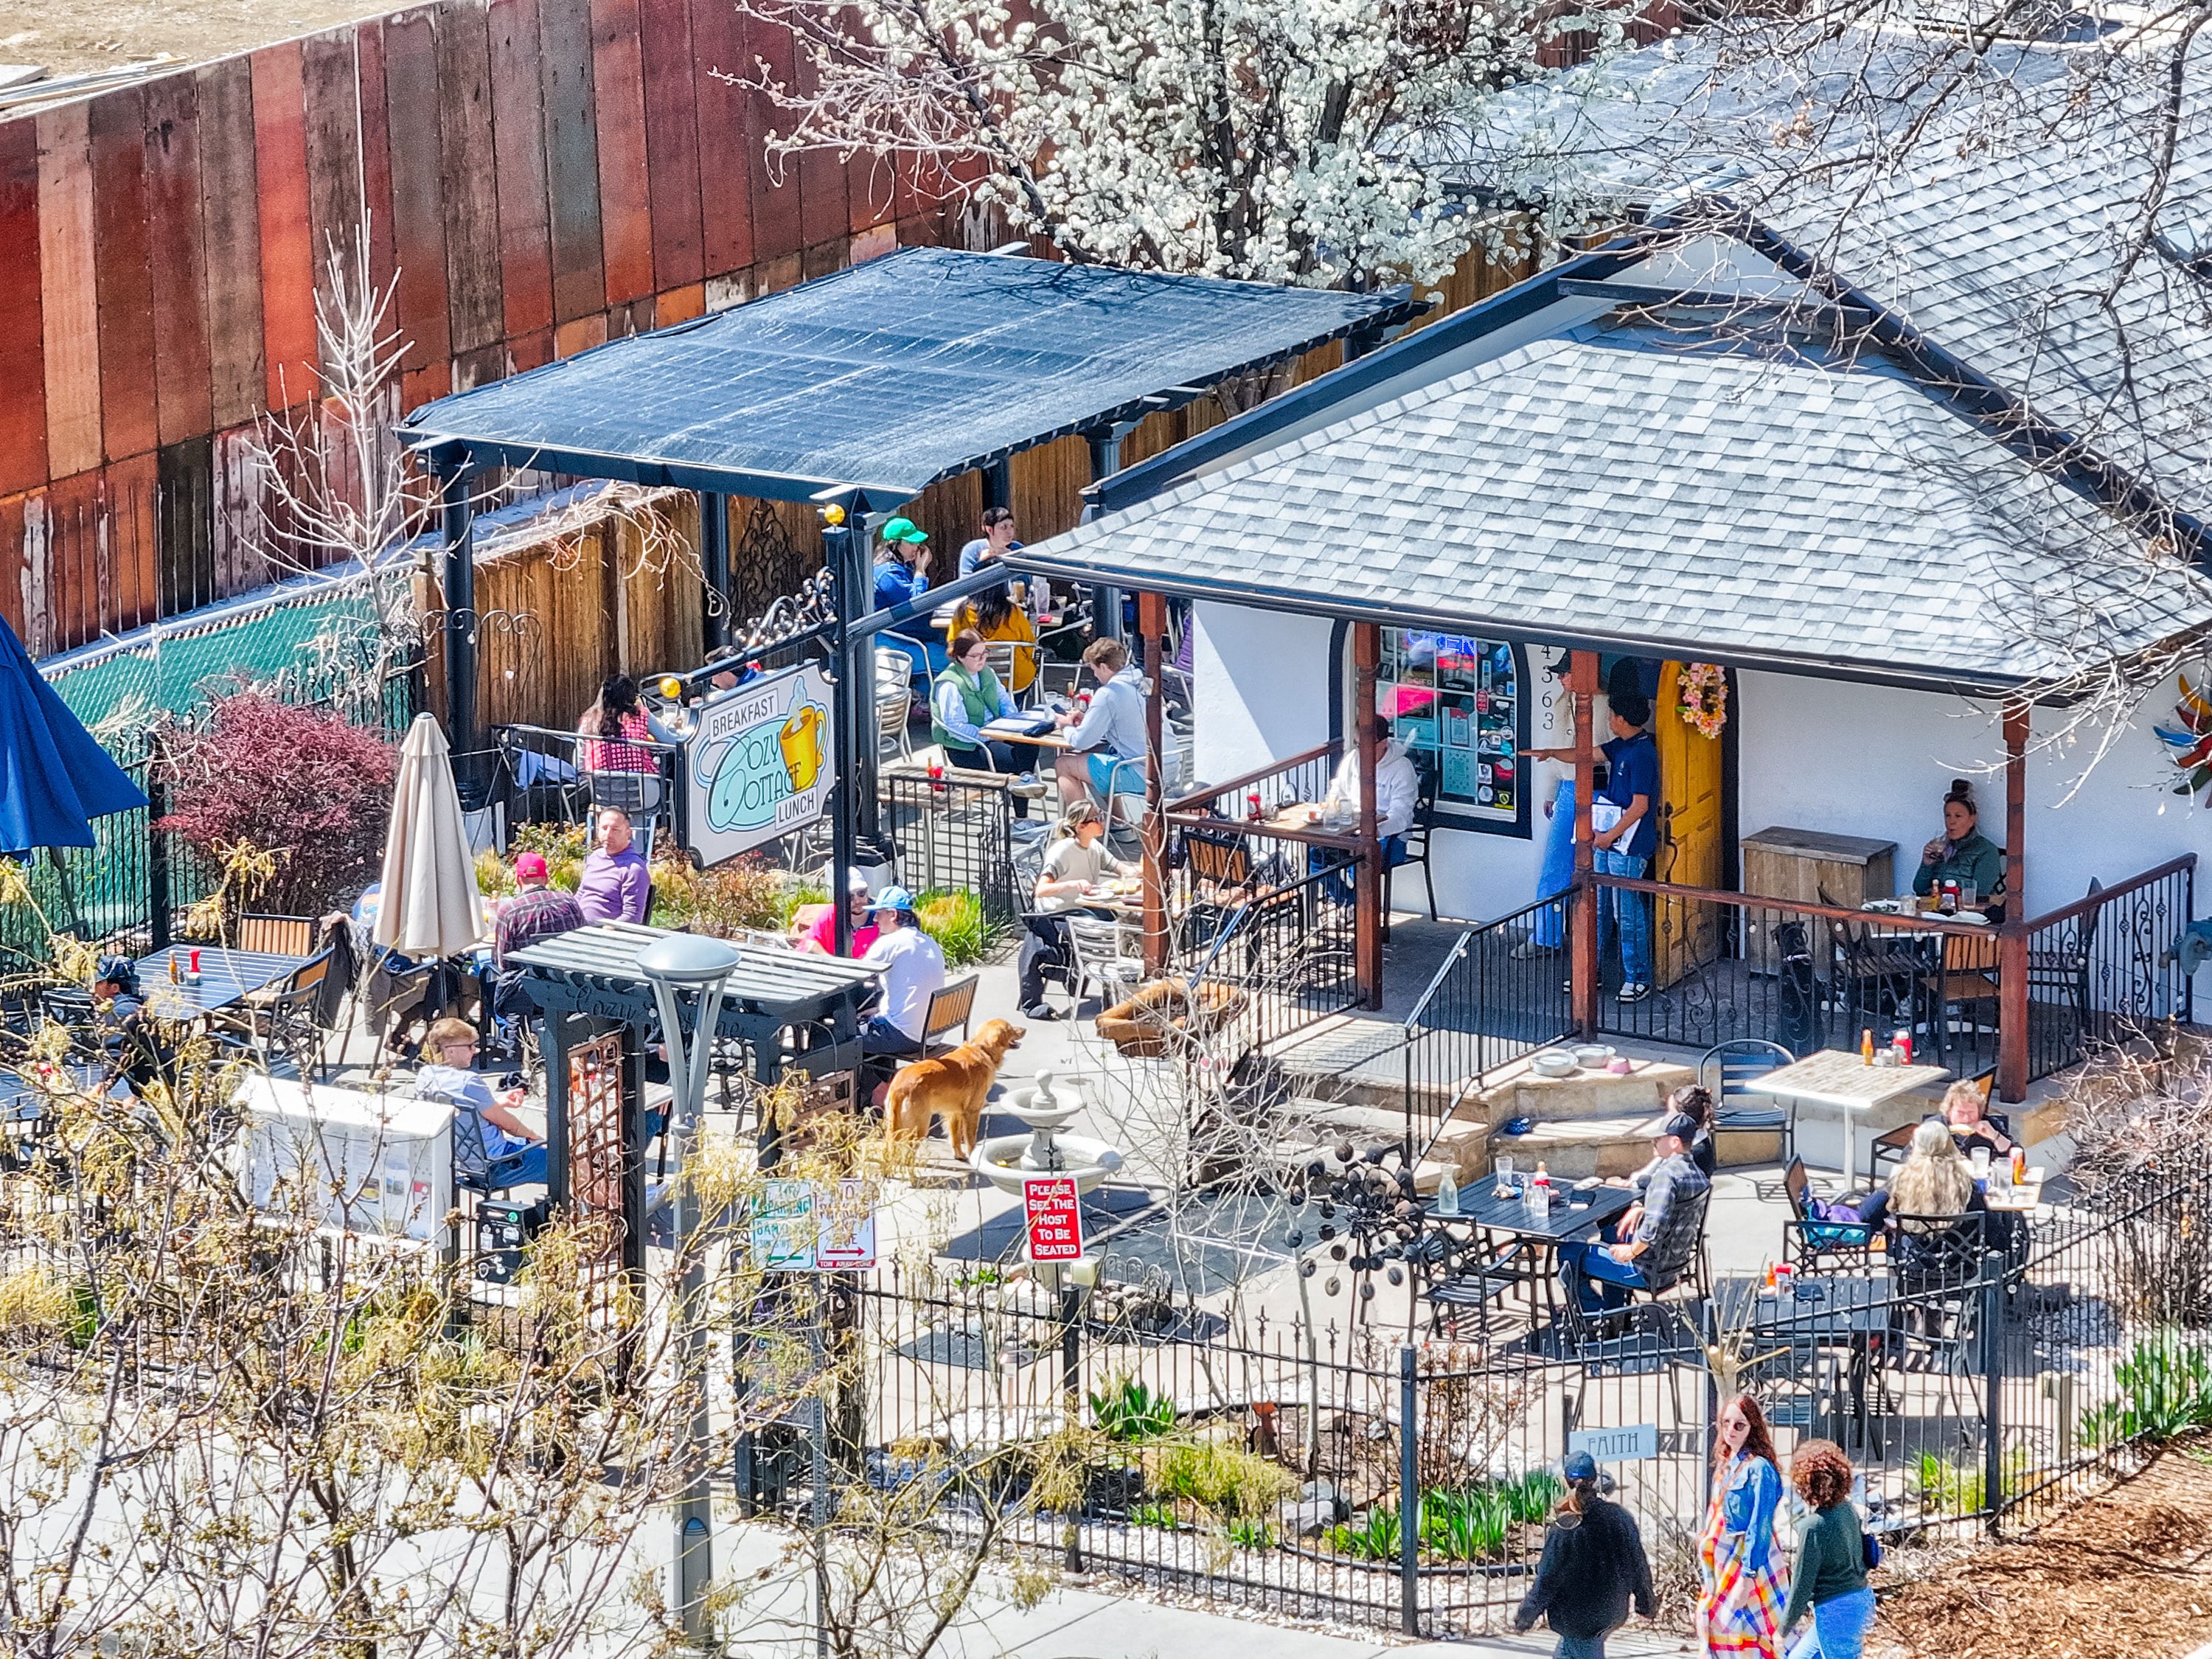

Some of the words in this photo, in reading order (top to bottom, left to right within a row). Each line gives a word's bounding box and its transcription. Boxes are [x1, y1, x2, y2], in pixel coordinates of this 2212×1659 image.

[1540, 645, 1554, 730] 4363
[712, 695, 775, 737] BREAKFAST
[778, 793, 815, 823] LUNCH
[1029, 1183, 1071, 1196] PLEASE
[1029, 1198, 1051, 1211] SEE
[1051, 1198, 1075, 1210] THE
[1038, 1214, 1068, 1225] HOST
[1037, 1228, 1053, 1240] TO
[1054, 1228, 1071, 1240] BE
[1034, 1243, 1077, 1256] SEATED
[1587, 1433, 1639, 1455] FAITH
